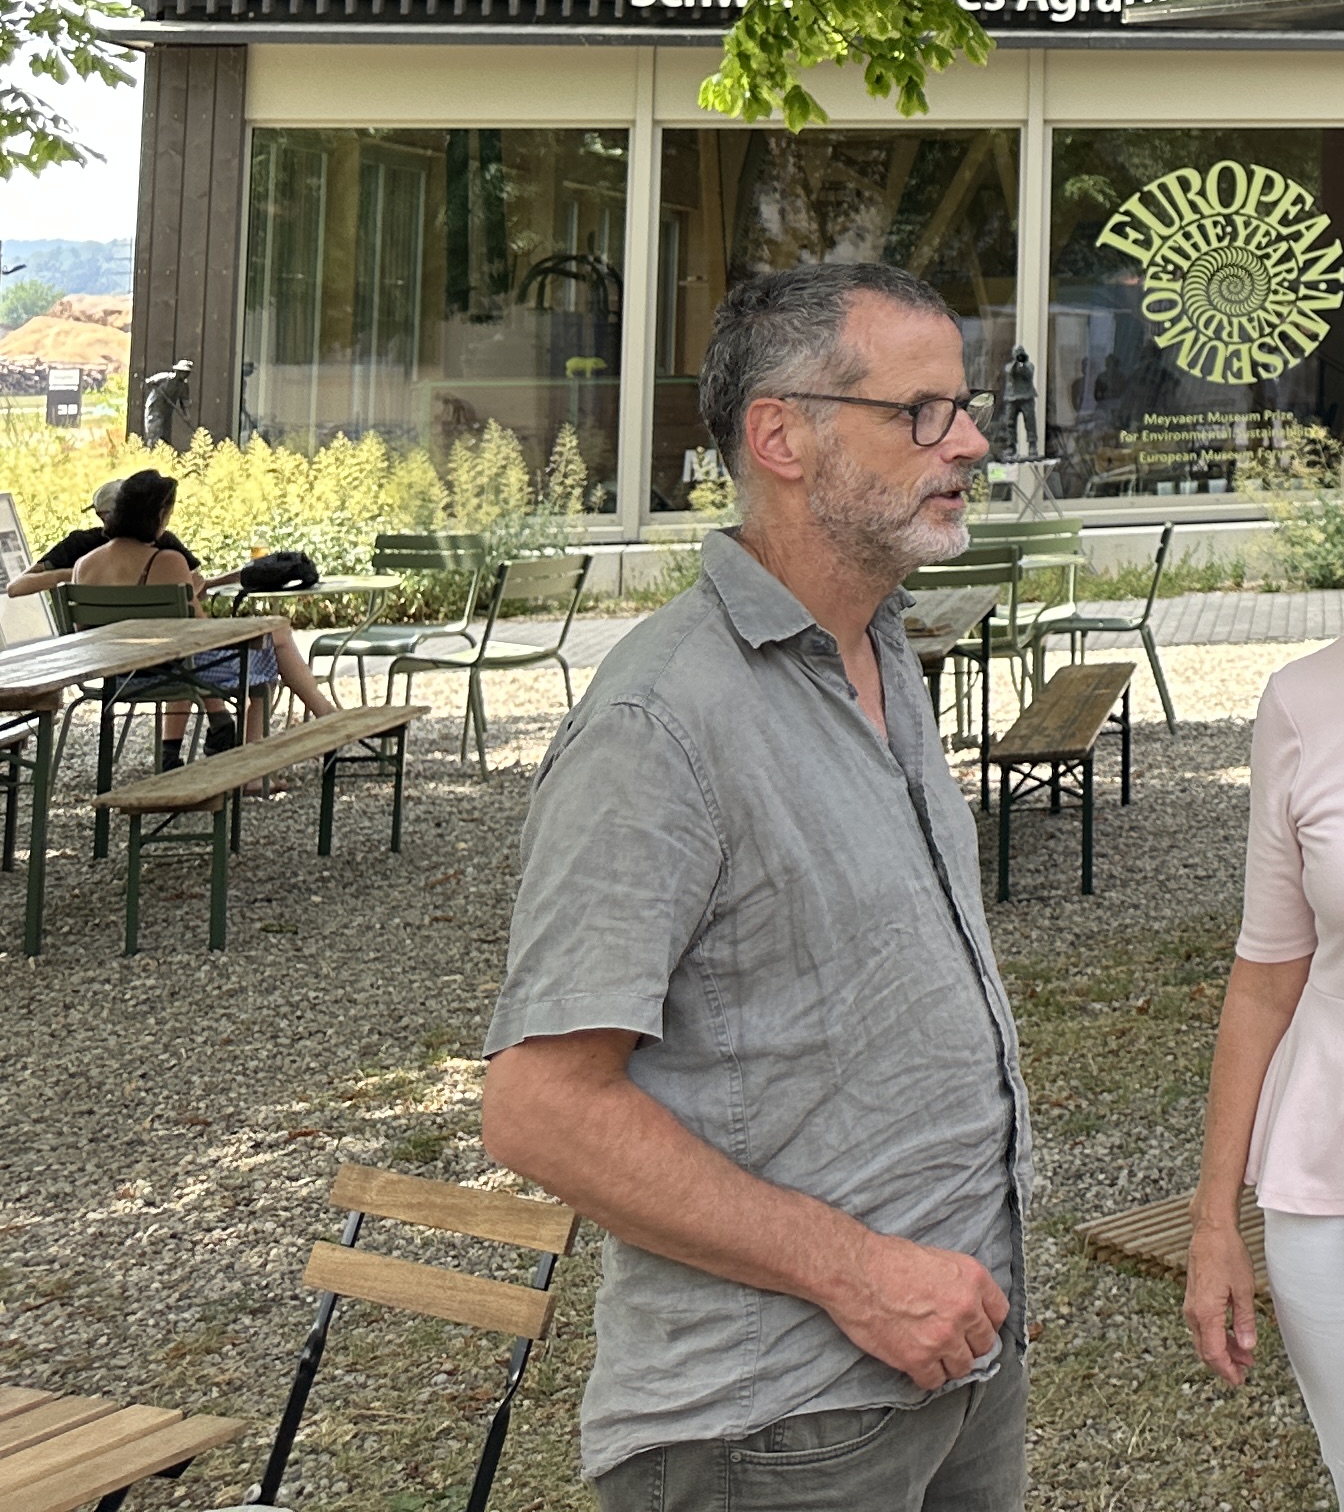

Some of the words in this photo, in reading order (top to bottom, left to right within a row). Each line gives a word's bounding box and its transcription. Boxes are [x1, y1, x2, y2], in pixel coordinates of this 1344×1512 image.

[1154, 214, 1231, 271] THE
[1231, 214, 1299, 283] YEAR
[1141, 266, 1183, 322] OF
[1198, 288, 1298, 342] AWARD
[1153, 283, 1344, 385] MUSEUM
[1207, 411, 1260, 424] Museum
